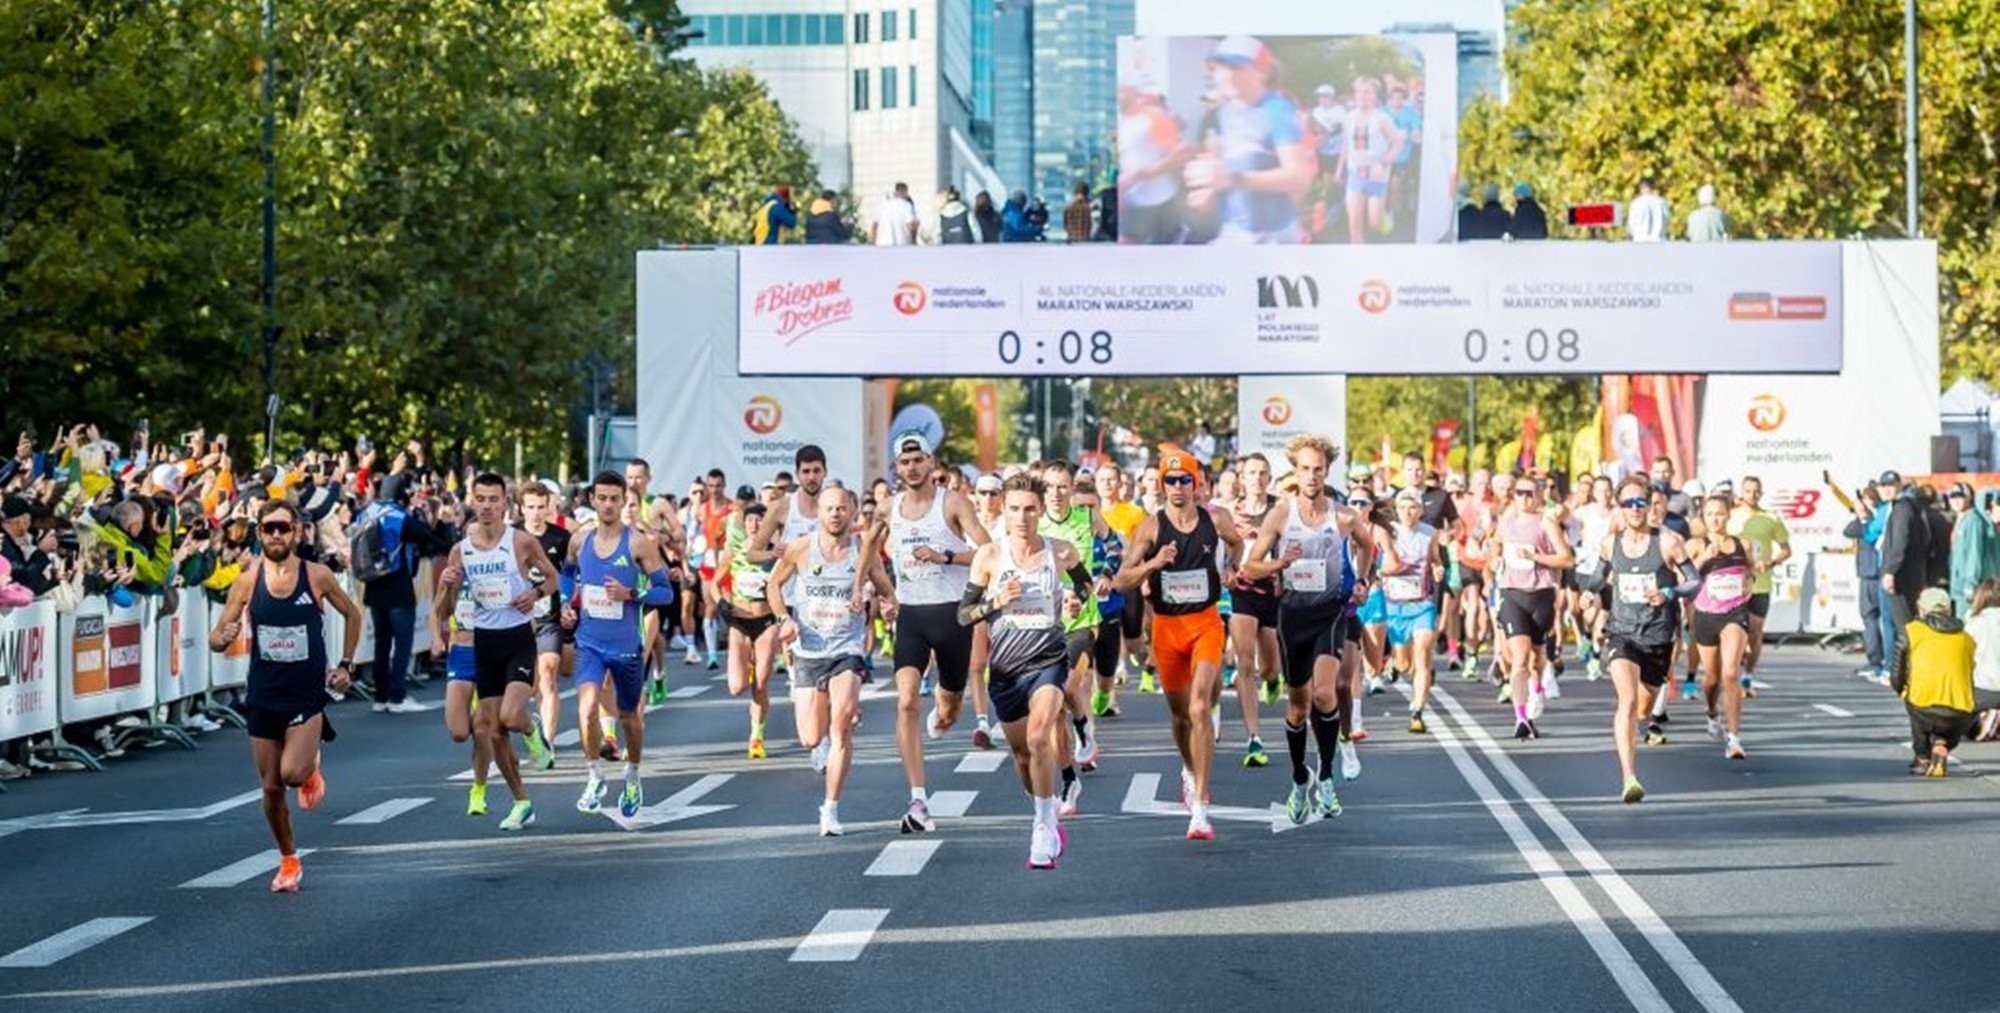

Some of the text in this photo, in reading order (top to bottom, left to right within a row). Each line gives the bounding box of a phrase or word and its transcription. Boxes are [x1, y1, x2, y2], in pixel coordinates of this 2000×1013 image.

[932, 286, 986, 296] nationale
[1397, 285, 1452, 295] nationale
[754, 277, 841, 316] #Biegam
[1397, 297, 1472, 307] nederlanden
[932, 298, 1005, 309] nederlanden
[1038, 300, 1194, 312] MARATON WARSZAWSKI
[1503, 297, 1661, 309] MARATON WARSZAWSKI
[776, 298, 853, 335] Dobrze
[1747, 438, 1810, 449] nationale
[1747, 452, 1833, 463] nederlanden
[467, 561, 507, 576] UKRAINE
